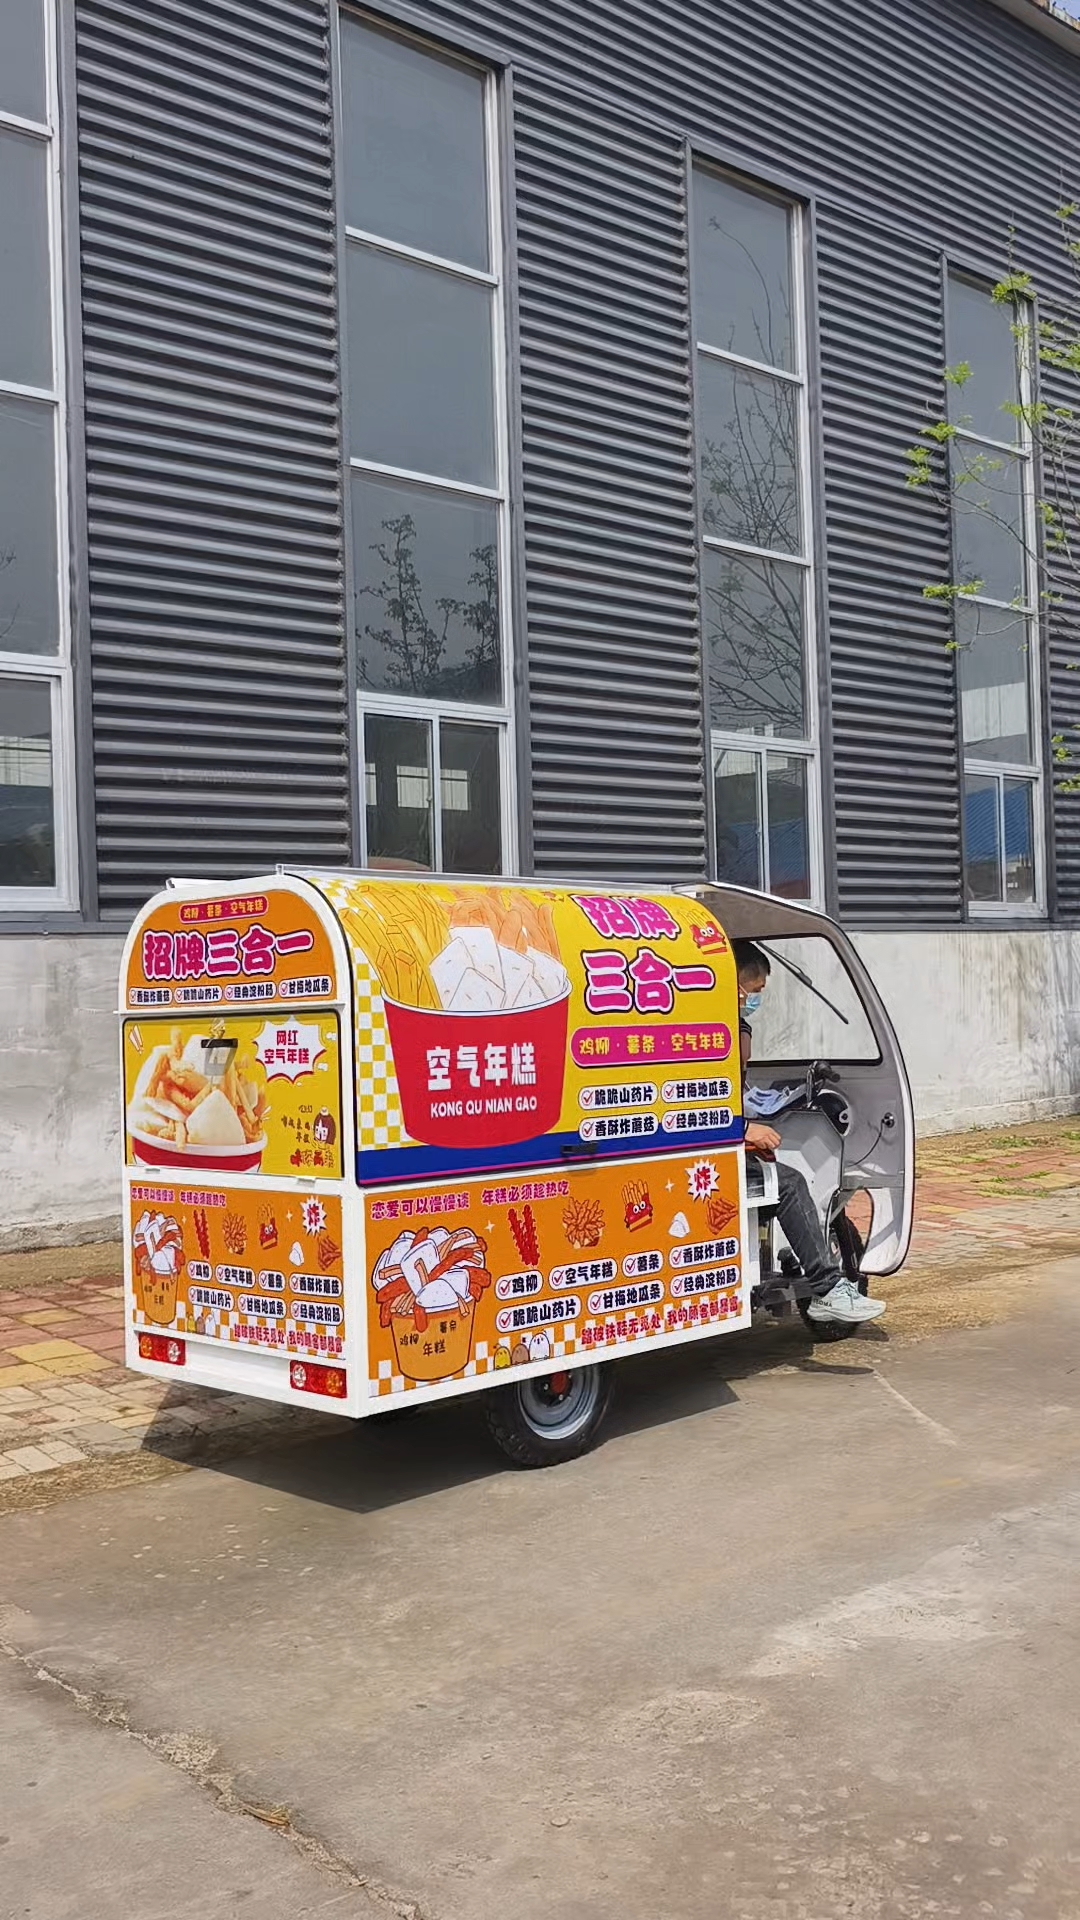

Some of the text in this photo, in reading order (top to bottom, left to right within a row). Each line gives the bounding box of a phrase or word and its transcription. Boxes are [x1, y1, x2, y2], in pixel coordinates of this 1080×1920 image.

[230, 899, 263, 914] 空气年糕
[571, 894, 680, 939] 招牌
[142, 926, 314, 978] 招牌三合一
[581, 948, 715, 1014] 三合一
[276, 1031, 299, 1045] 网红
[579, 1031, 725, 1055] 鸡柳 薯条 空气年糕
[265, 1048, 309, 1065] 空气年糕
[426, 1042, 536, 1091] 空气年糕
[595, 1087, 653, 1105] 脆脆山药片
[675, 1080, 729, 1099] 甘梅地瓜条
[430, 1096, 537, 1118] KONG QU NIAN GAO
[595, 1117, 654, 1136] 香酥炸蘑菇
[675, 1110, 729, 1129] 经典淀粉肠
[694, 1166, 711, 1192] 炸
[307, 1205, 320, 1225] 炸
[370, 1193, 469, 1219] 恋爱可以慢慢谈
[683, 1243, 736, 1265] 香酥炸蘑菇
[565, 1264, 613, 1285] 空气年糕
[637, 1257, 659, 1273] 薯条
[224, 1270, 252, 1284] 空气年糕
[512, 1276, 538, 1294] 鸡柳
[683, 1271, 736, 1292] 经典淀粉肠
[603, 1285, 660, 1307] 甘梅地瓜条
[513, 1304, 576, 1326] 脆脆山药片
[581, 1314, 661, 1345] 踏破铁鞋无觅处
[423, 1340, 446, 1356] 年糕
